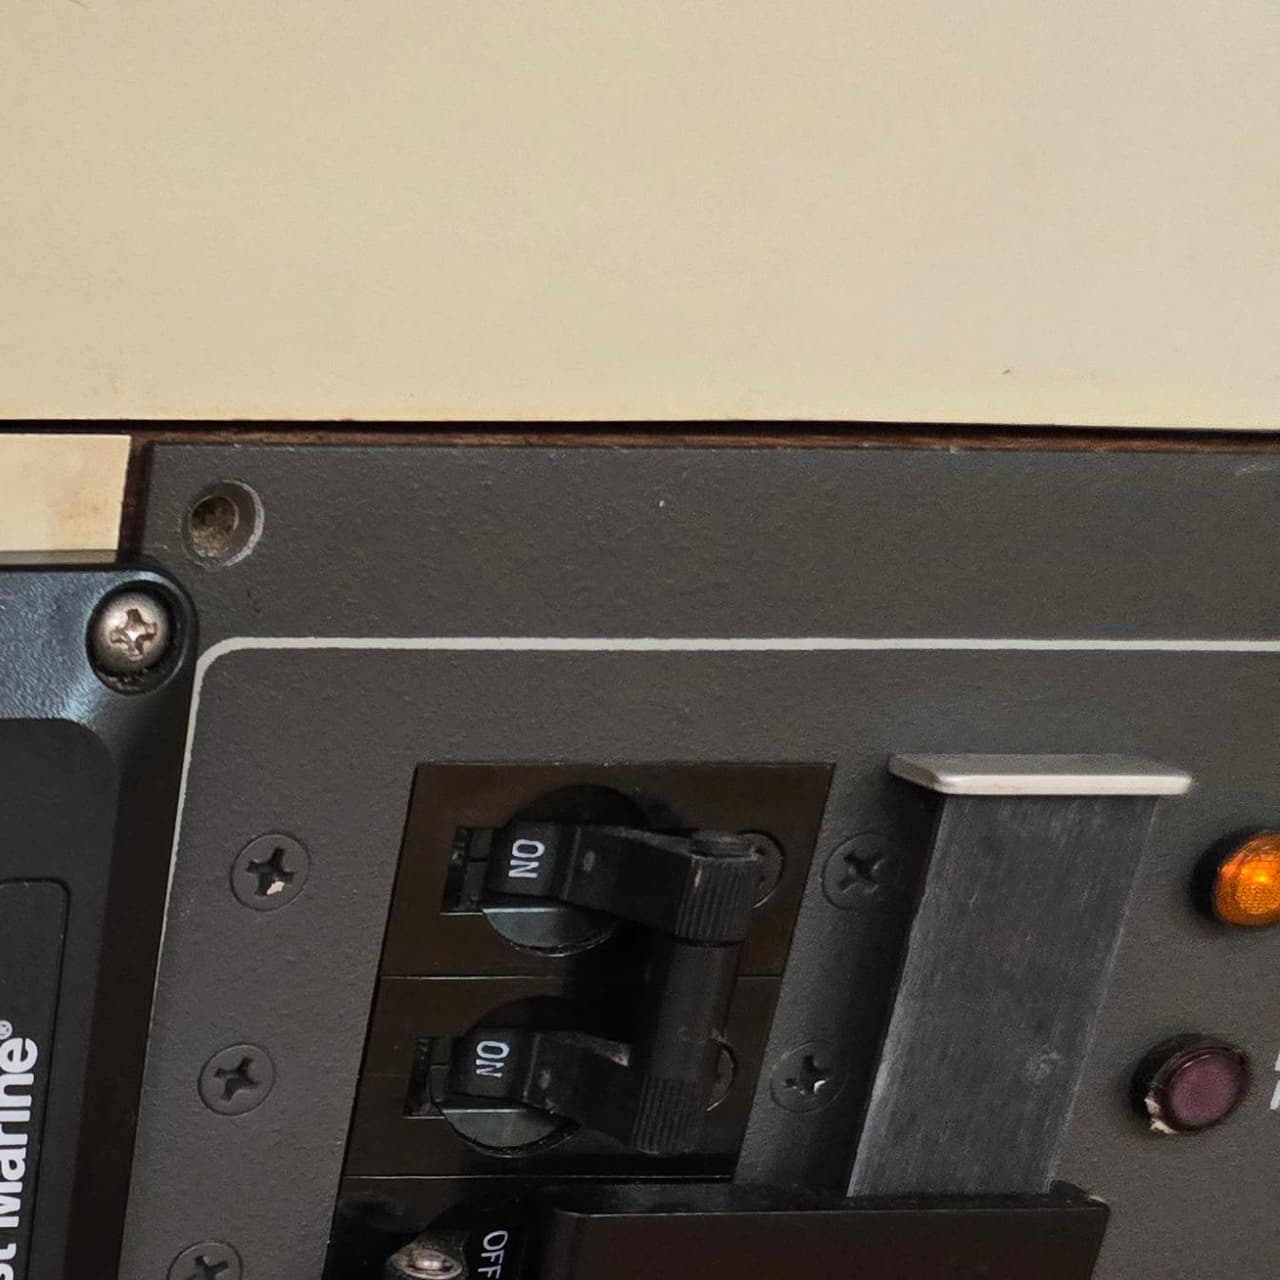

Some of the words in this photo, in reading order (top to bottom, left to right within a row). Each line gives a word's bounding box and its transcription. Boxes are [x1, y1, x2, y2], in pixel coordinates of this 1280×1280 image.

[508, 838, 545, 878] ON
[475, 1040, 510, 1078] ON
[477, 1230, 509, 1279] OFF
